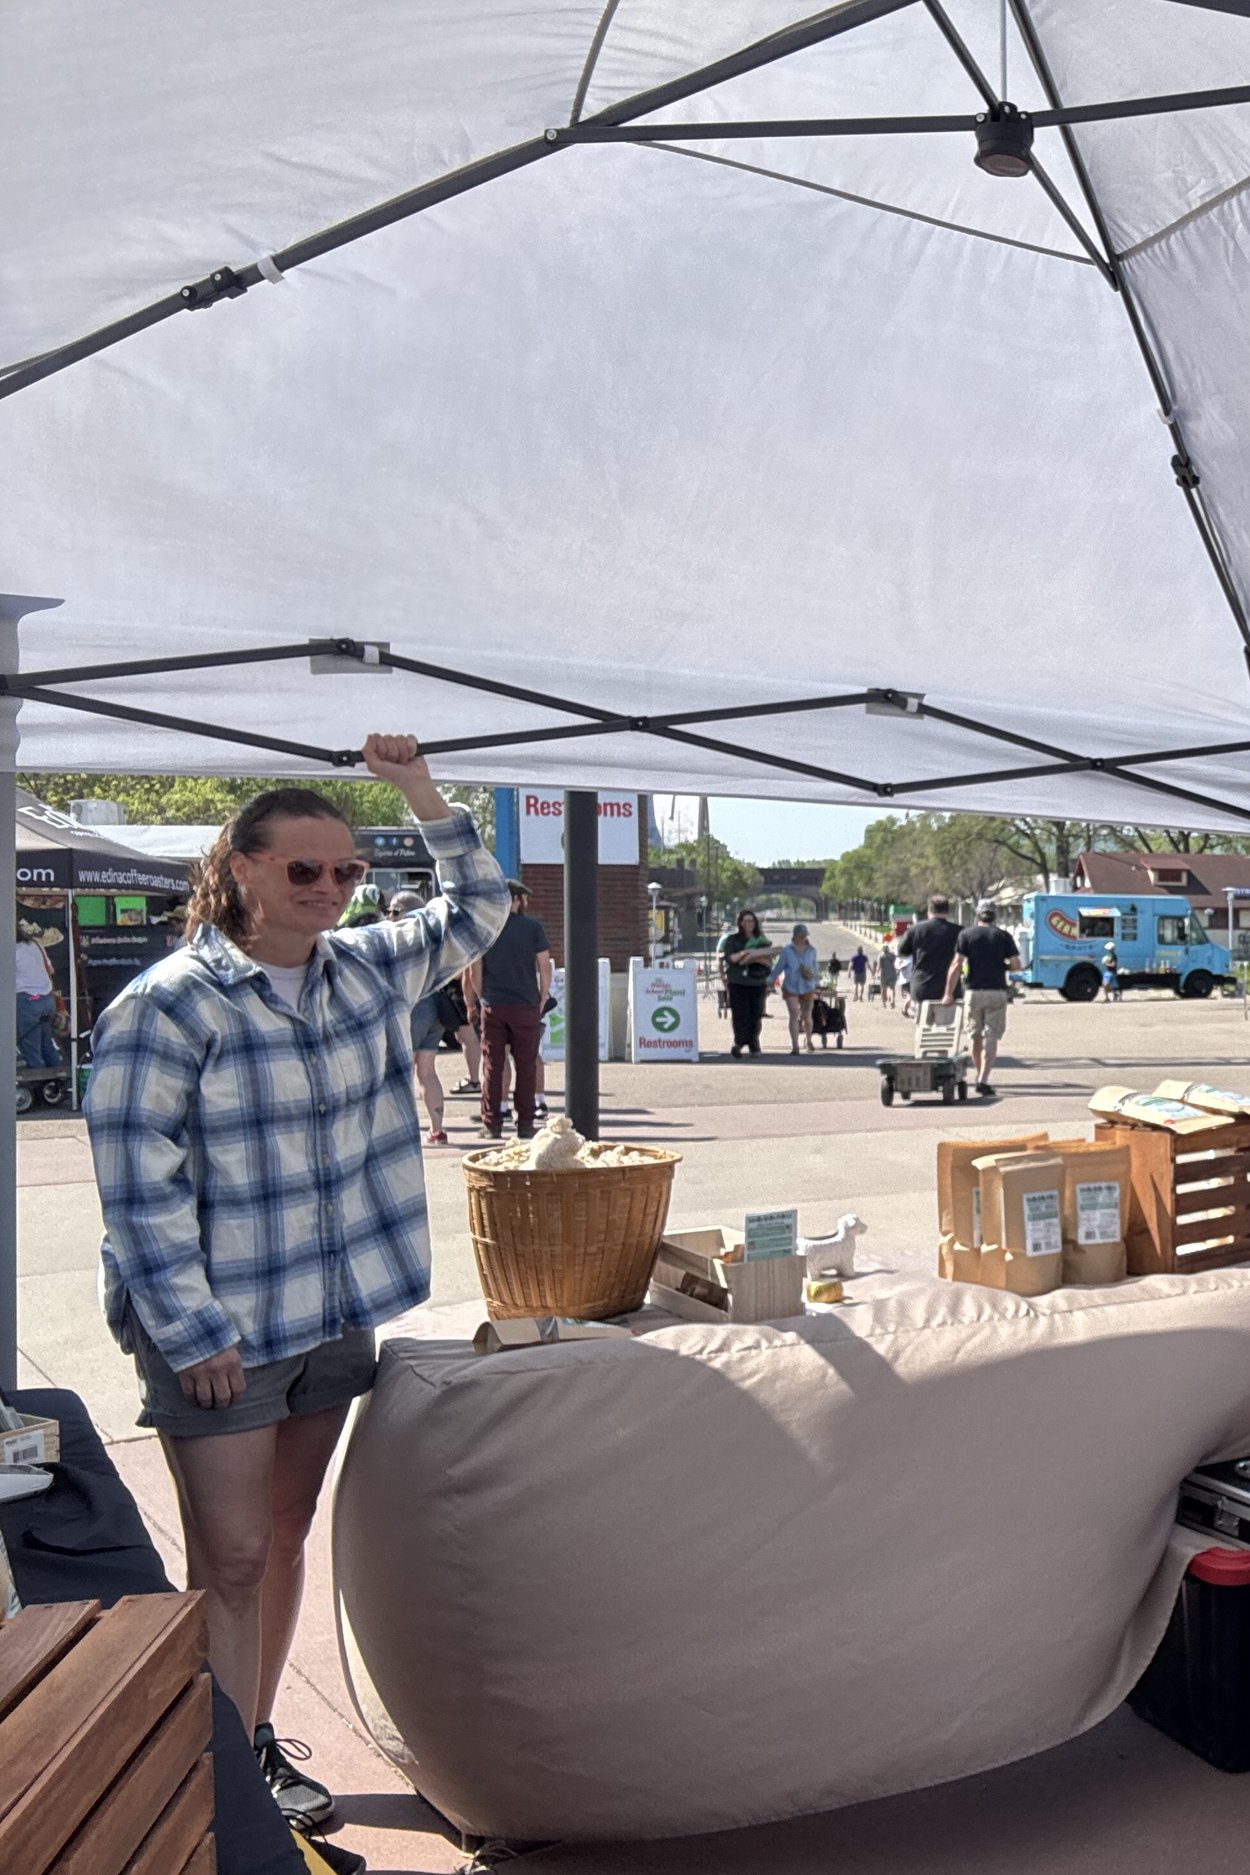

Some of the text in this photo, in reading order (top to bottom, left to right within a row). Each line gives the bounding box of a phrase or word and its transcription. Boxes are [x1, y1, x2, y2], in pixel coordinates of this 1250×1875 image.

[525, 794, 633, 818] Resms
[78, 867, 190, 892] www.edinacoffeeroasters.com
[638, 1036, 694, 1050] Restrooms
